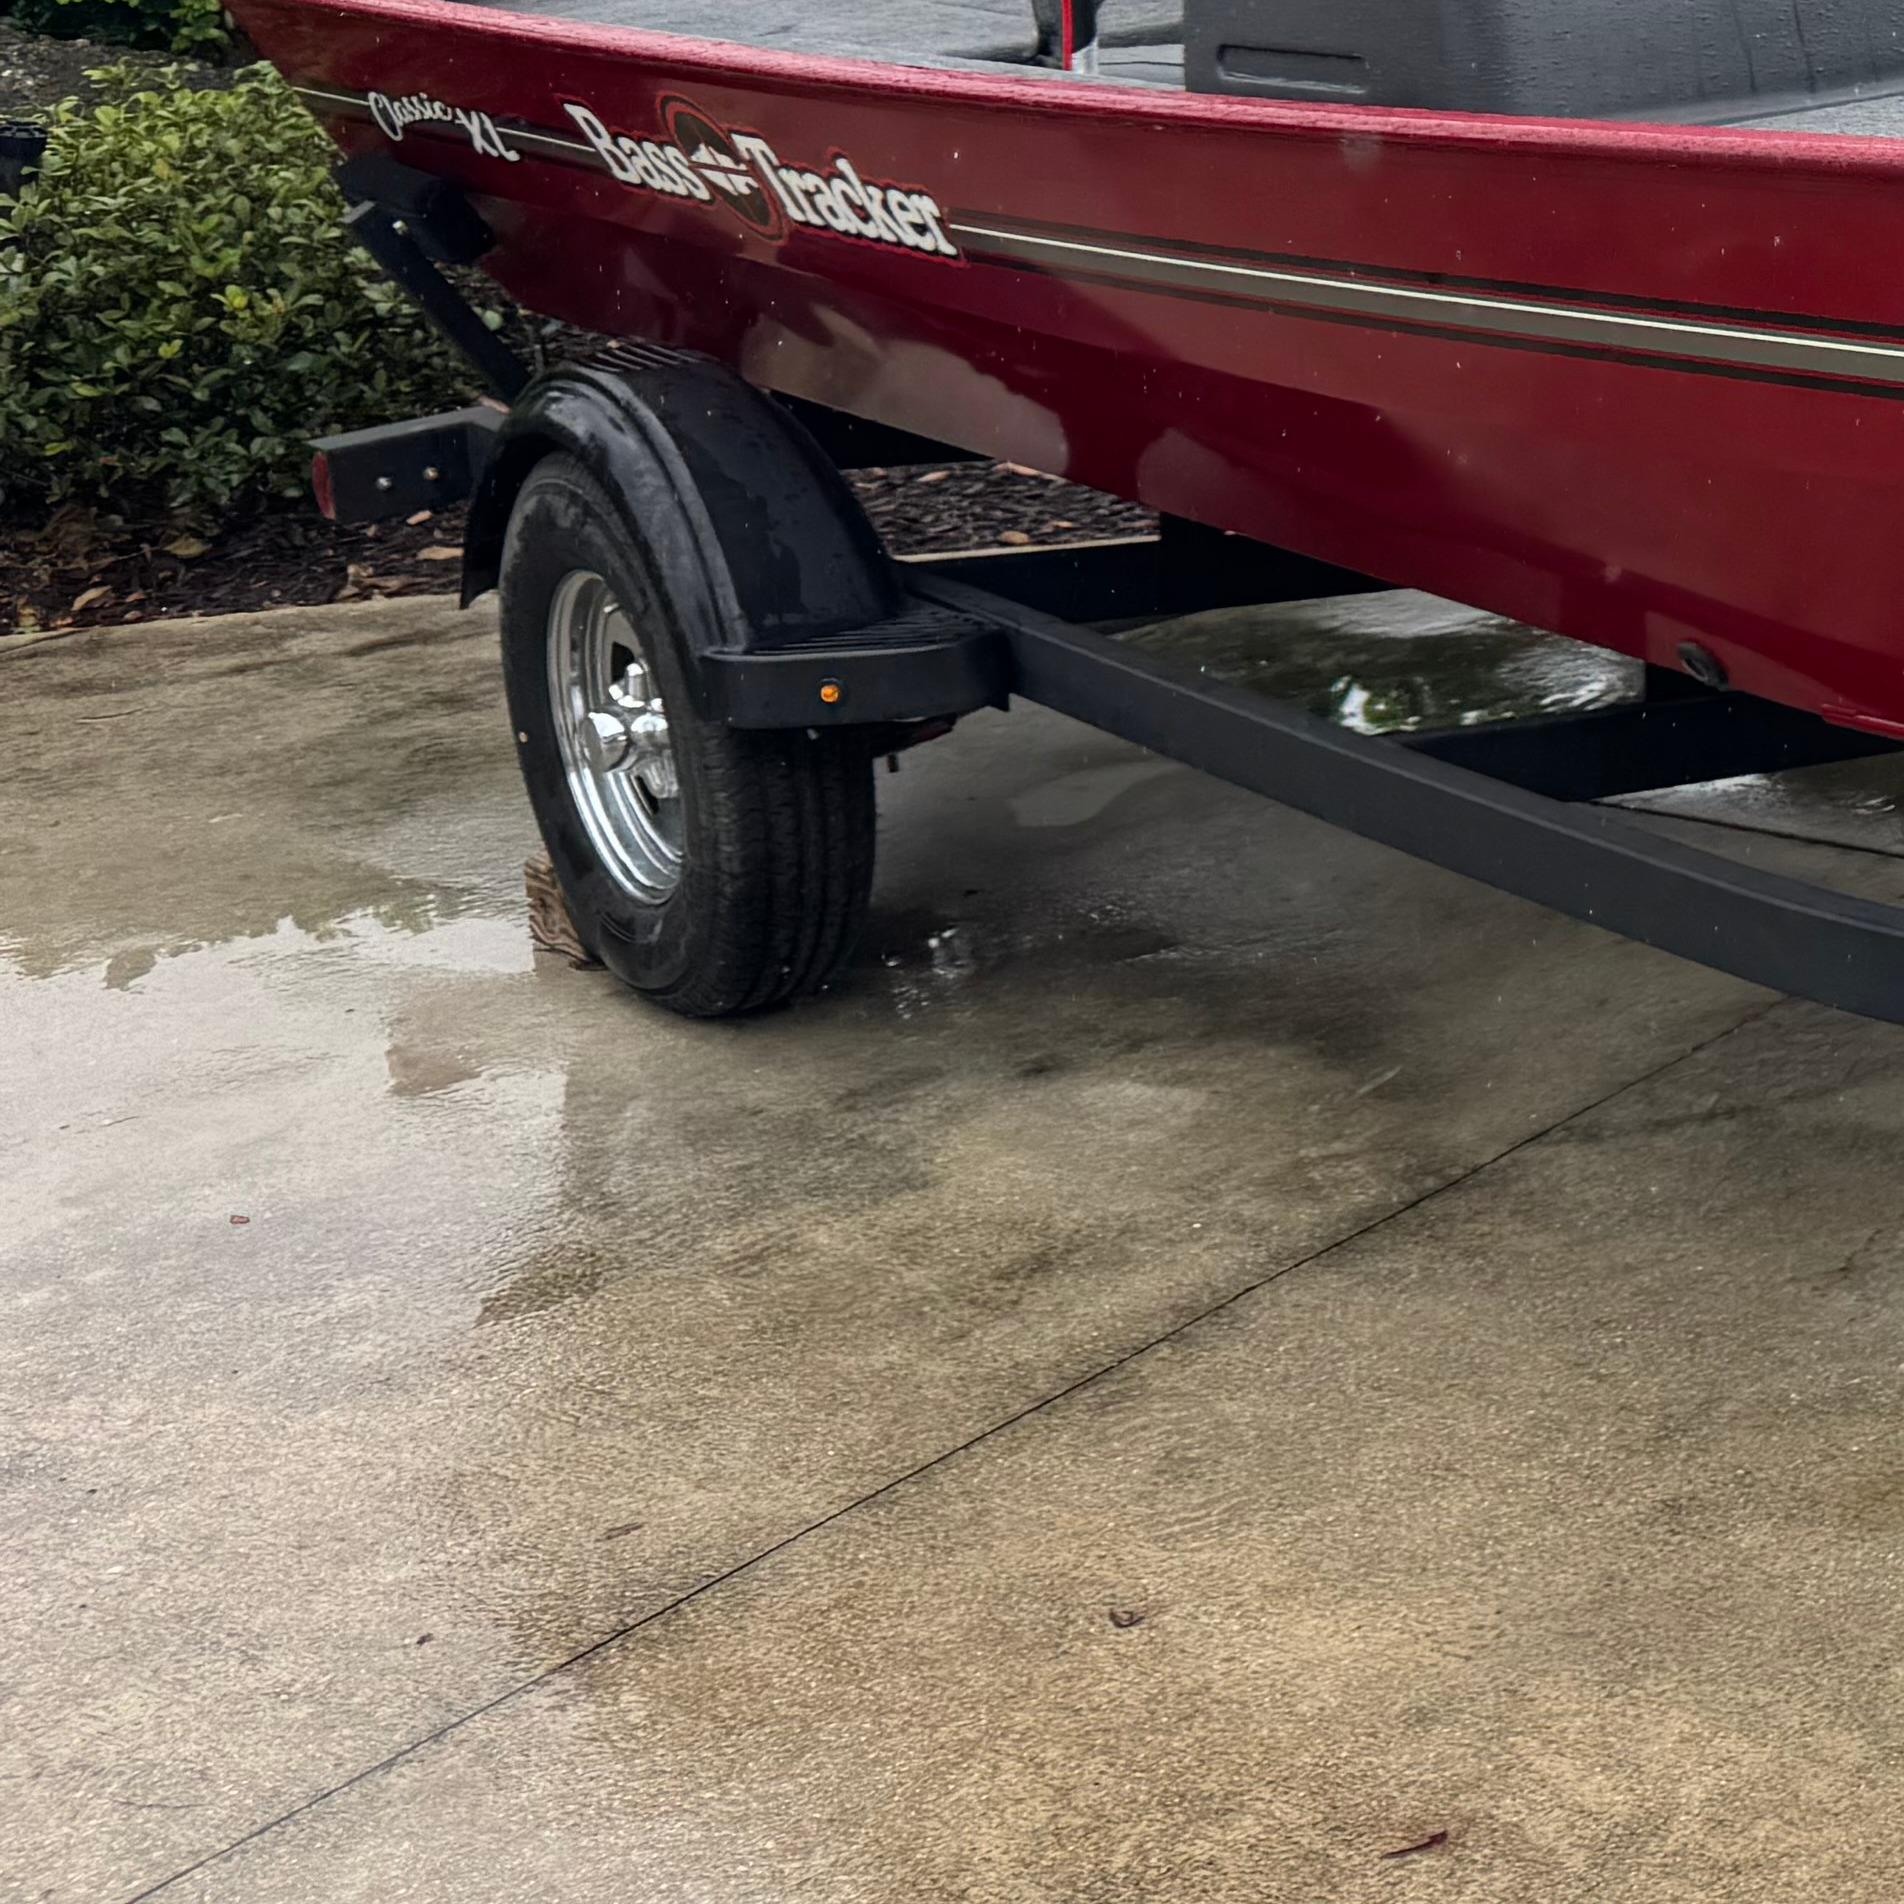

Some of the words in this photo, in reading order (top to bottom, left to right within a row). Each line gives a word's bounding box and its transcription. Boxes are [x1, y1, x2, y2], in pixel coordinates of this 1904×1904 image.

[367, 92, 454, 142] Classic
[453, 104, 521, 162] XL
[564, 102, 711, 202] Bass
[730, 132, 958, 257] Tracker
